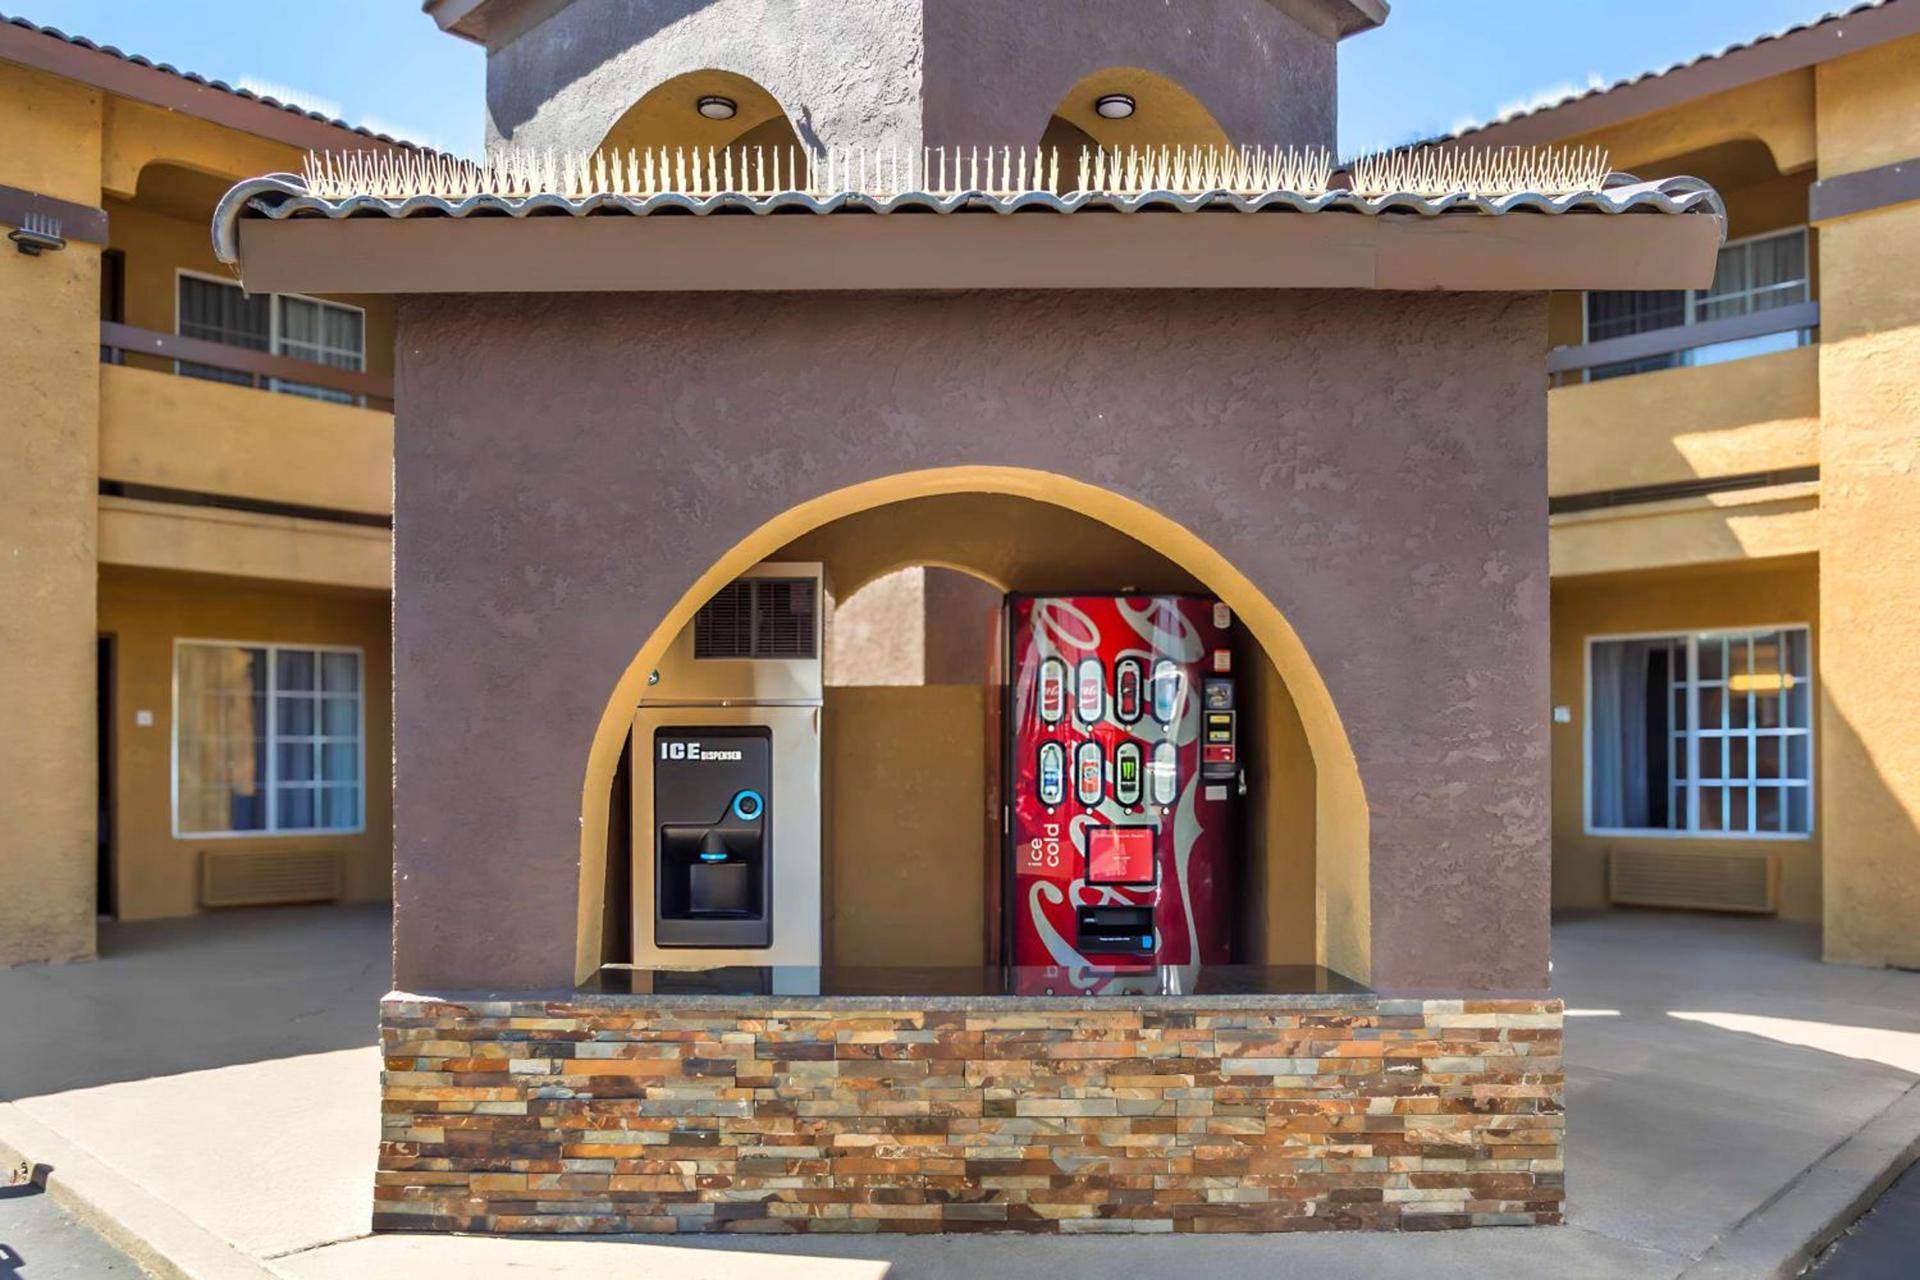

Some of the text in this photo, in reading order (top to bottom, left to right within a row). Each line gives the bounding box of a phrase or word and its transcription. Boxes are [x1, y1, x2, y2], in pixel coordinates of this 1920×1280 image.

[661, 742, 742, 760] ICE DISPENSER
[1028, 838, 1043, 867] ice
[1044, 823, 1060, 868] cold
